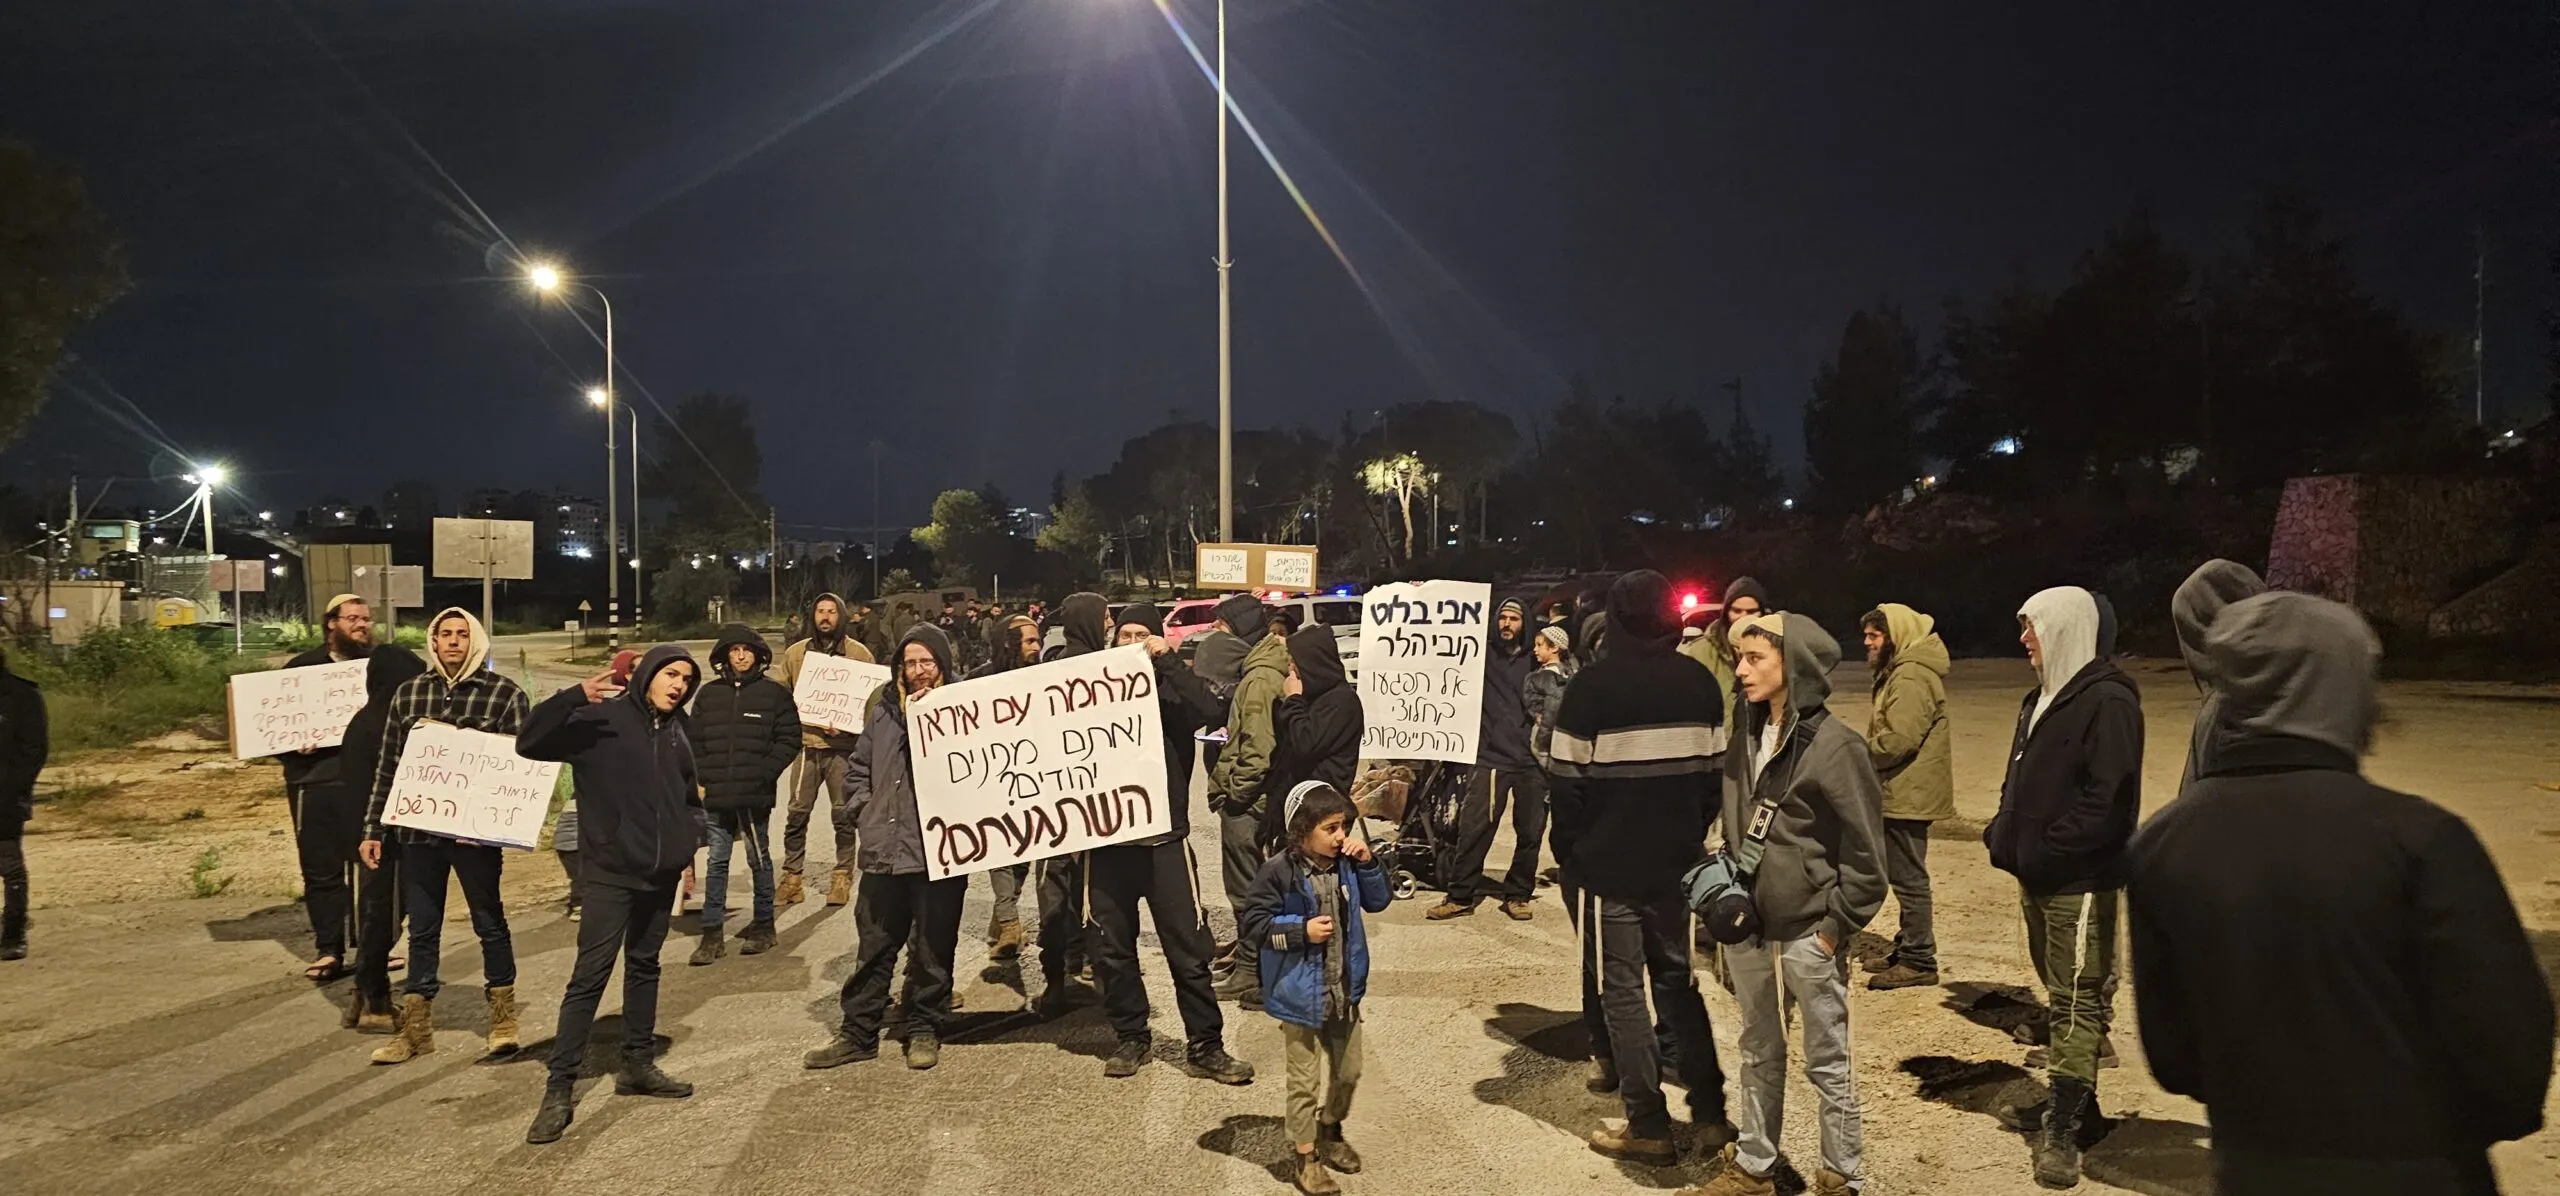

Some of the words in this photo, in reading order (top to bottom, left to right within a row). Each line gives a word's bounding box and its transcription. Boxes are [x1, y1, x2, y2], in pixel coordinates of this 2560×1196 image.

[1370, 594, 1432, 626] בלוט
[1437, 599, 1483, 625] אבי
[1377, 627, 1427, 657] הלר
[1432, 634, 1479, 666] קובי
[280, 675, 302, 689] עם
[321, 666, 361, 681] מלחמה
[1373, 671, 1430, 696] תפגעו
[1441, 668, 1468, 698] אל
[1044, 666, 1151, 716] מלחמה
[993, 692, 1031, 726] עם
[1392, 696, 1456, 726] בחלוצי
[917, 700, 979, 758] איראן
[1063, 714, 1142, 761] ואתם
[416, 745, 449, 759] את
[460, 752, 515, 773] תפקירו
[947, 739, 1038, 789] מפנים
[400, 765, 469, 789] המולדת
[524, 762, 551, 776] אל
[1000, 762, 1098, 806] יהודים?
[492, 785, 540, 801] אדמות
[484, 806, 523, 826] לידי
[926, 784, 1153, 876] השתגעתם?
